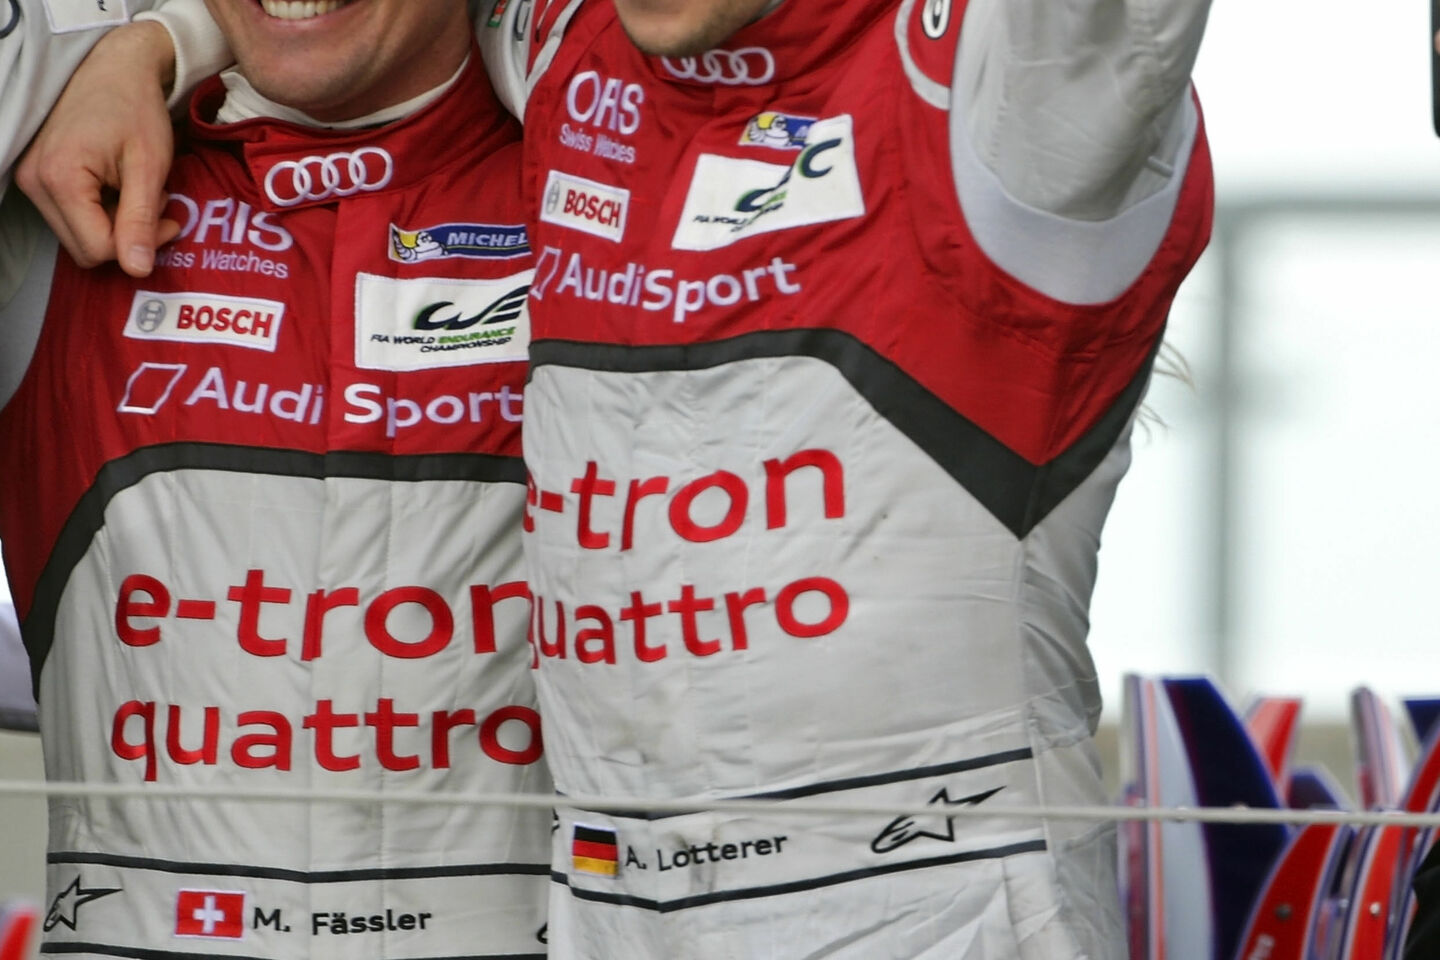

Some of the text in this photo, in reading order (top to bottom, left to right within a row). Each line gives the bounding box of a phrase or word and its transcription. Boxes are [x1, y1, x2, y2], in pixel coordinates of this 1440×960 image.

[563, 189, 622, 228] BOSCH
[201, 248, 290, 279] Watches
[176, 304, 273, 339] BOSCH
[393, 334, 436, 345] WORLD
[439, 326, 517, 344] ENDURANCE
[185, 366, 524, 438] Audi Sport
[111, 697, 545, 782] quattro
[625, 835, 788, 872] A. Lotterer
[252, 907, 432, 936] M. Fässler
